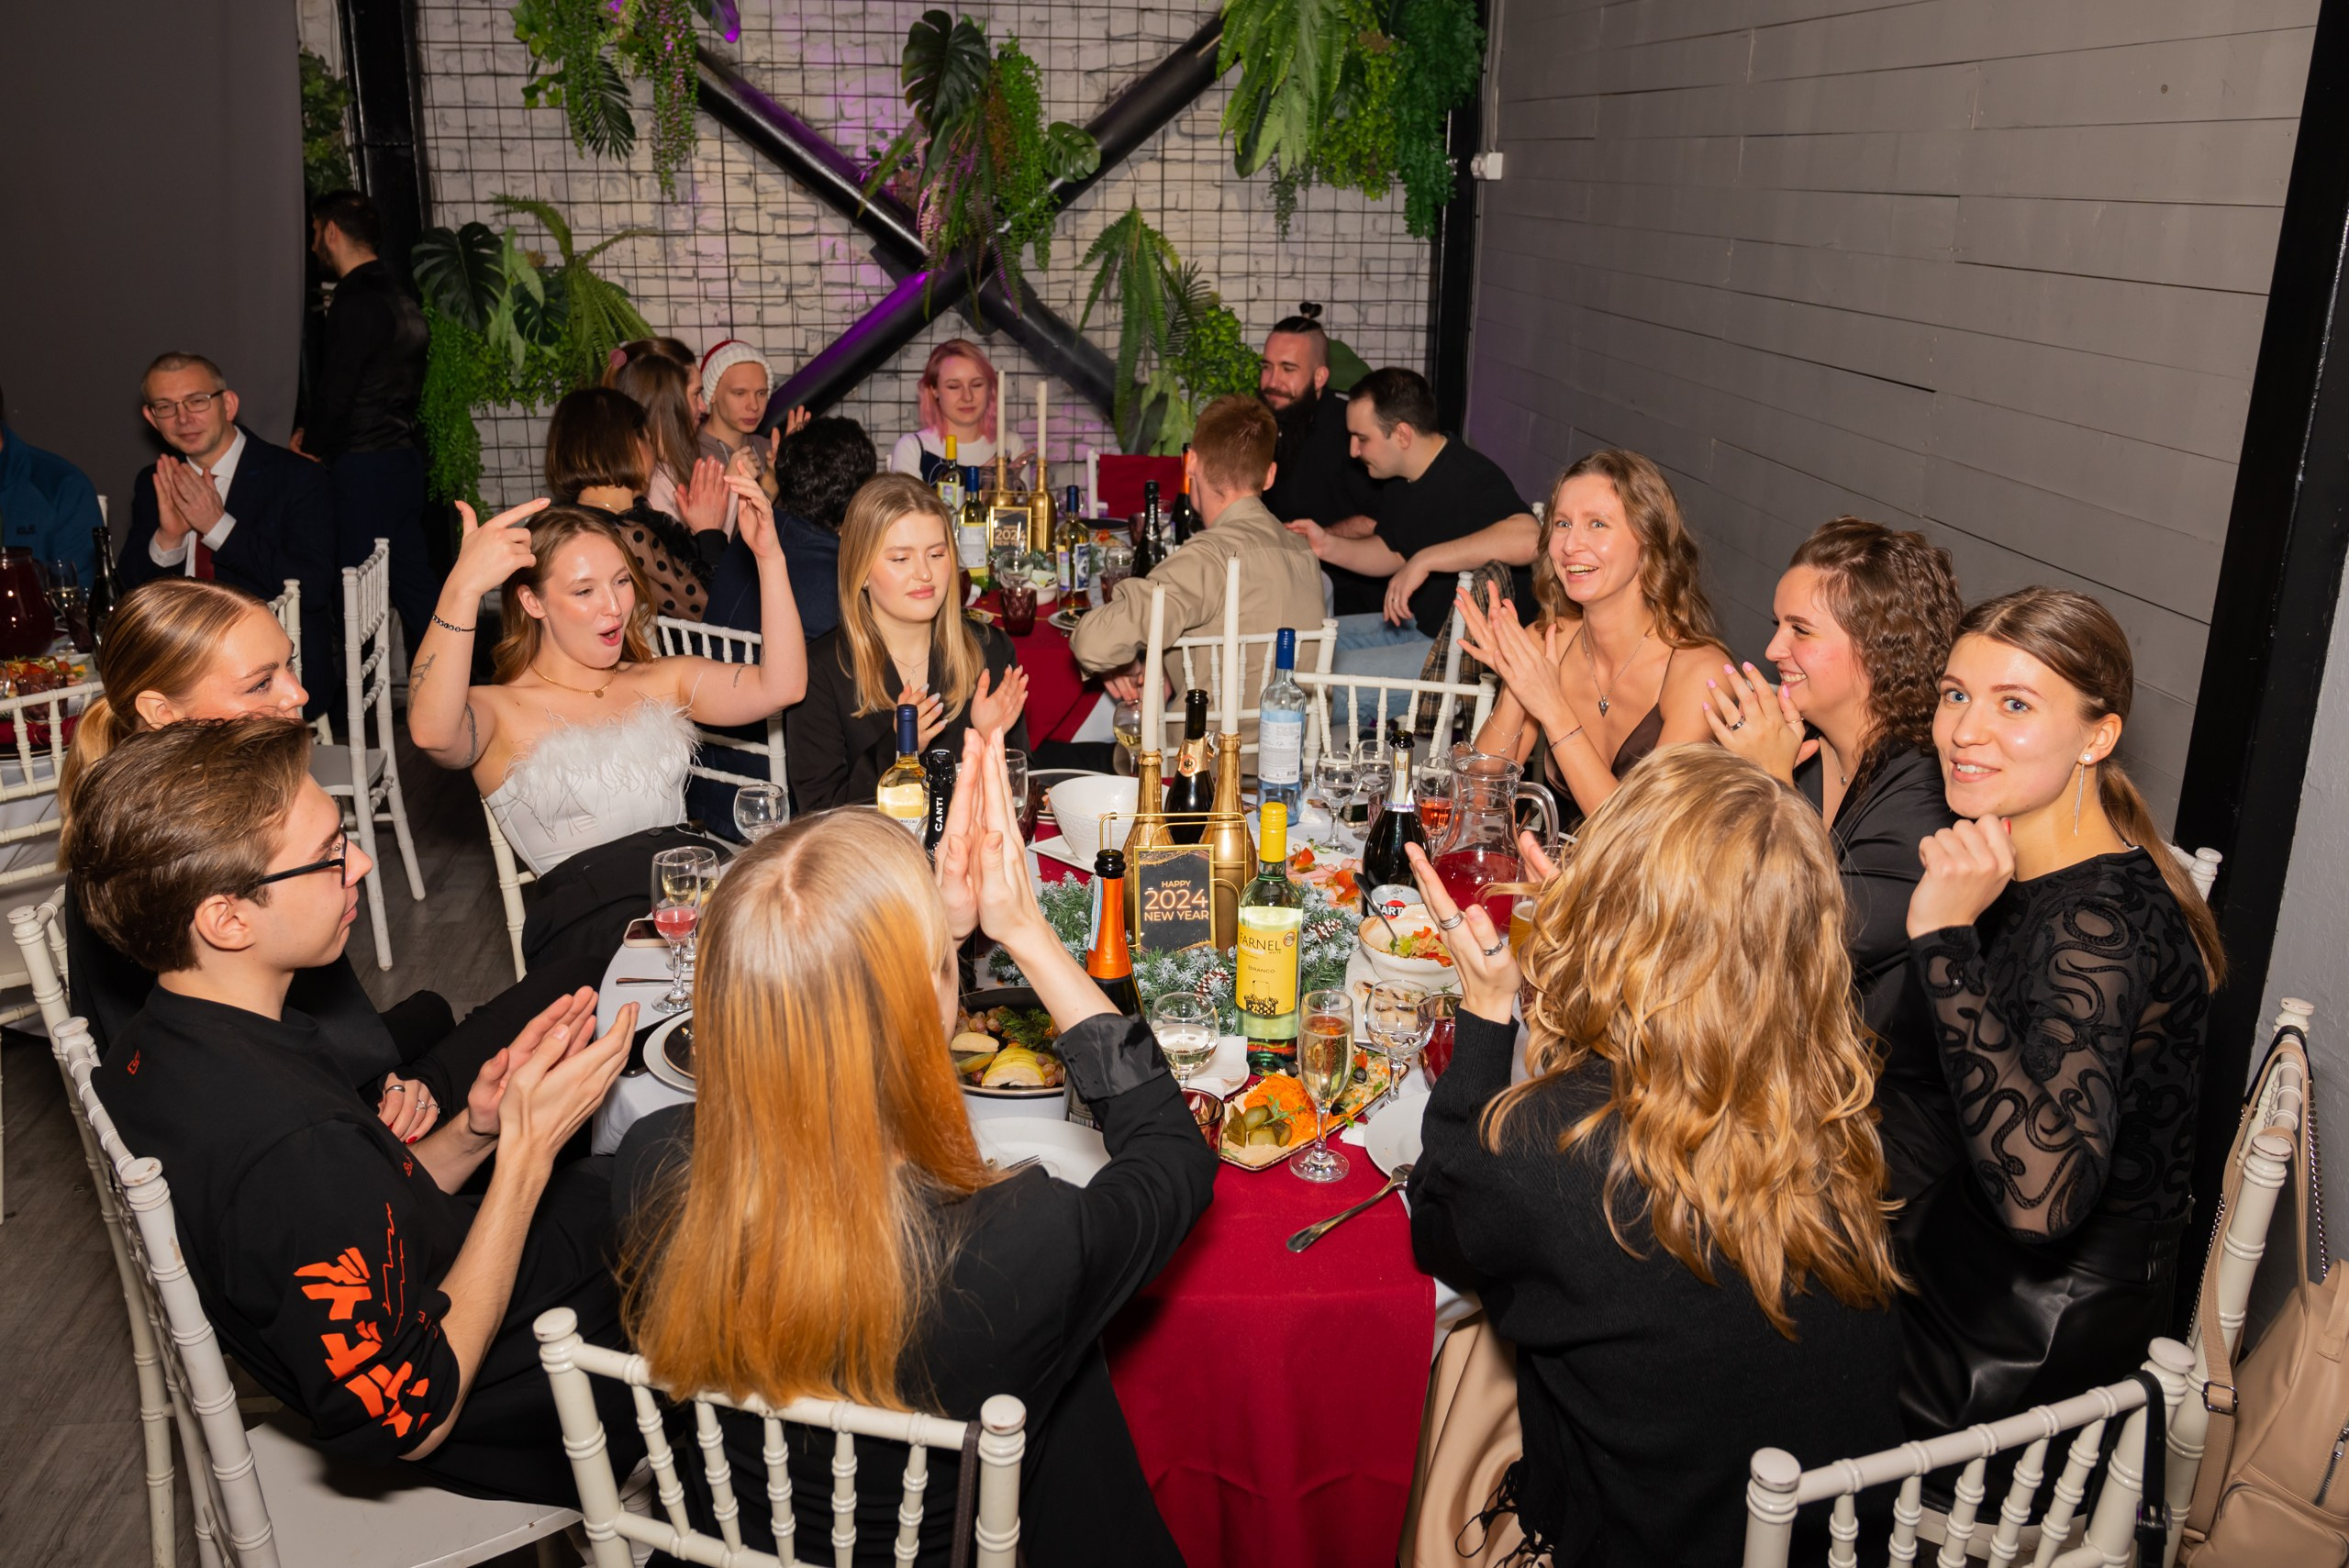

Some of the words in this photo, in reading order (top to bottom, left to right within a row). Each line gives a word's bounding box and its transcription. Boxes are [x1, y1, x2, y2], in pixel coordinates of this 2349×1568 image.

[934, 796, 943, 832] CANTI
[1144, 888, 1208, 910] 2024
[1144, 911, 1174, 922] NEW
[1176, 910, 1209, 920] YEAR
[1239, 932, 1282, 951] FARNEL
